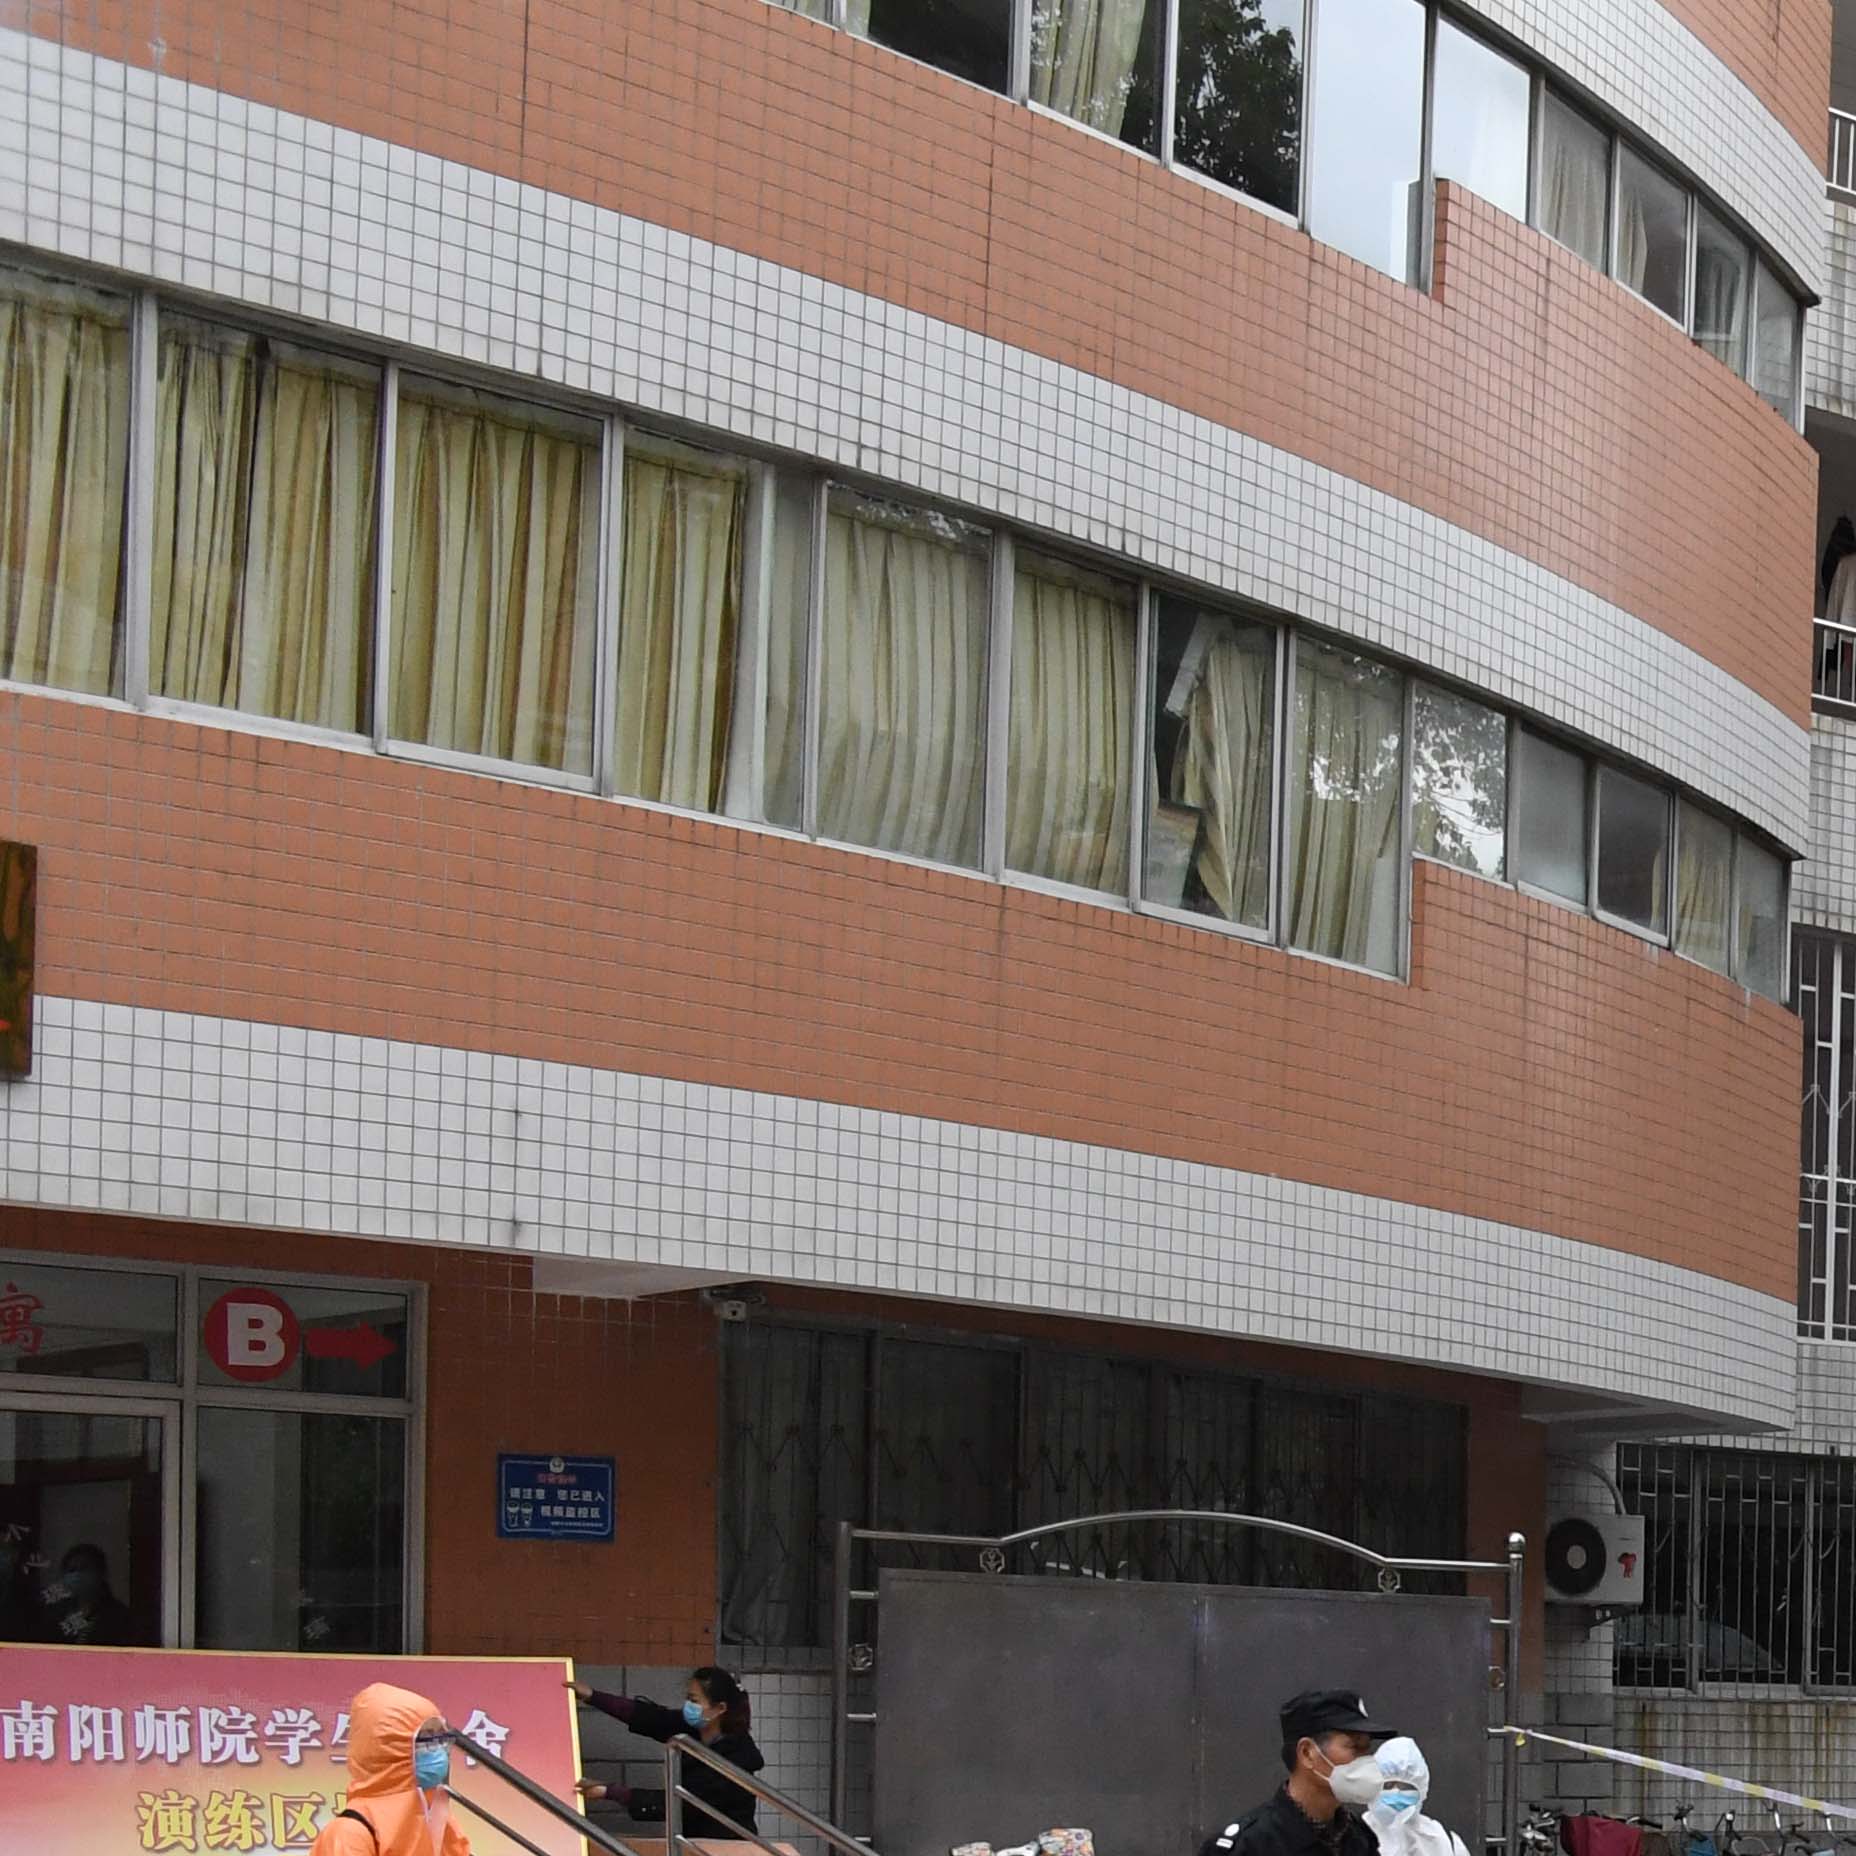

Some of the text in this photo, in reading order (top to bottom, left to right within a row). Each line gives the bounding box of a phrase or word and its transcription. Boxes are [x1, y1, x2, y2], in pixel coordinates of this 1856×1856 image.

[226, 1302, 286, 1367] B
[0, 1699, 510, 1767] 南阳师院学舍
[136, 1788, 348, 1851] 演练区
